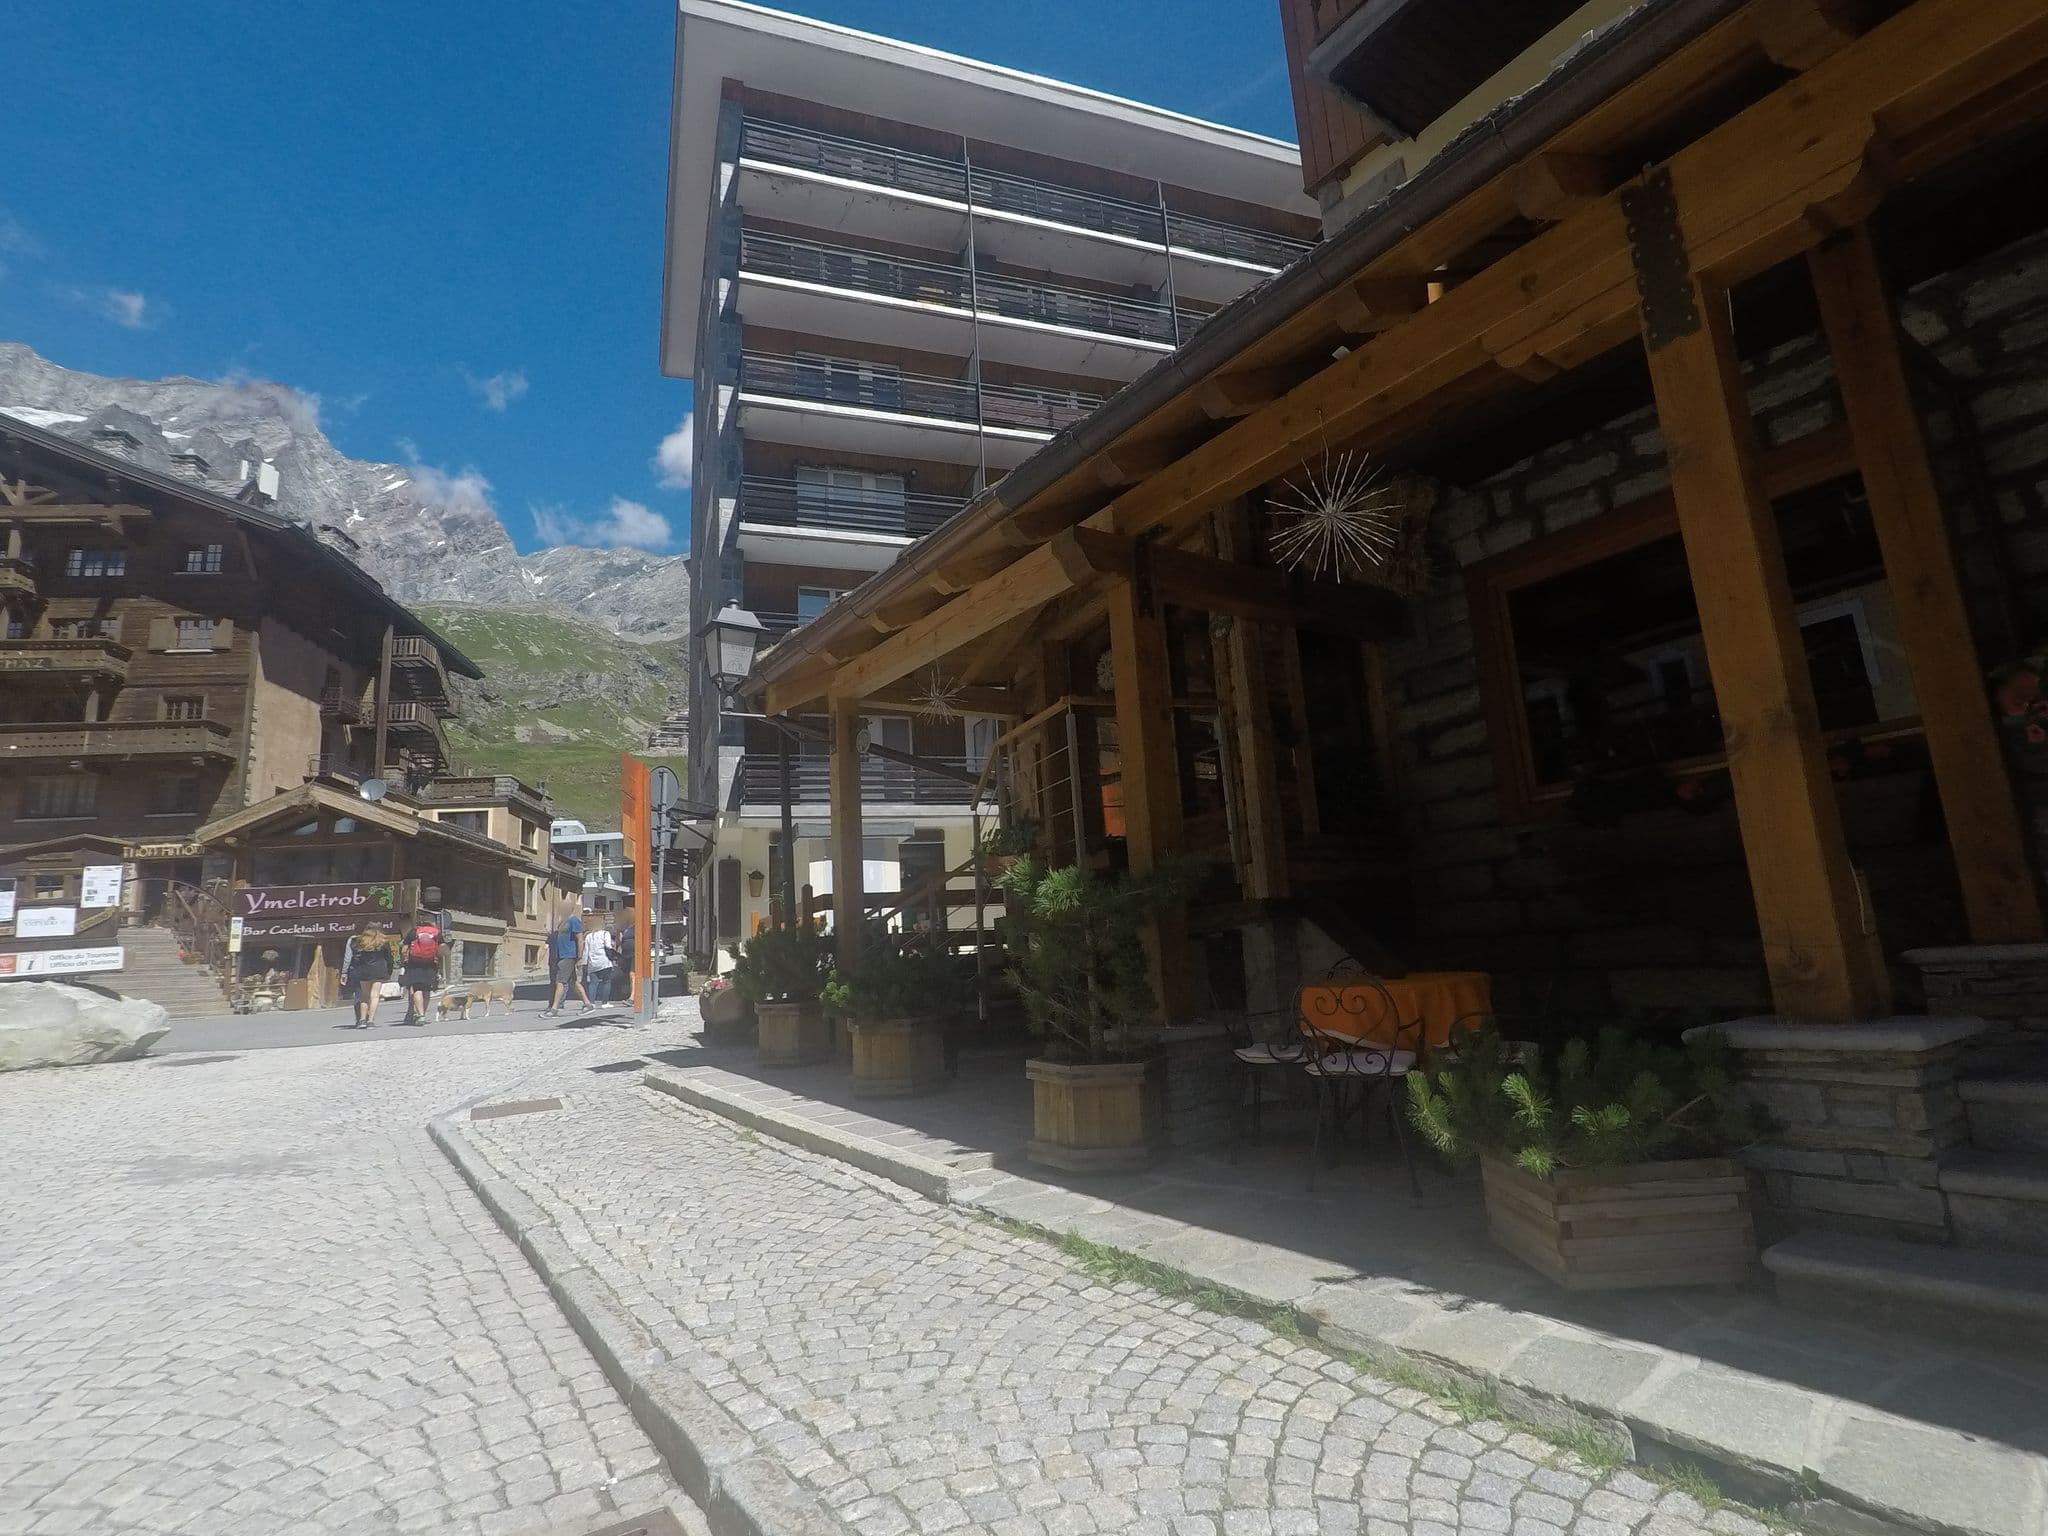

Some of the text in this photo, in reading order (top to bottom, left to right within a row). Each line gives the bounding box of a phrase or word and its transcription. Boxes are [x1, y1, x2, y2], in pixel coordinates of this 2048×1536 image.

[245, 888, 367, 914] Ymeletrob
[243, 921, 393, 936] Bar Cocktails Restnt
